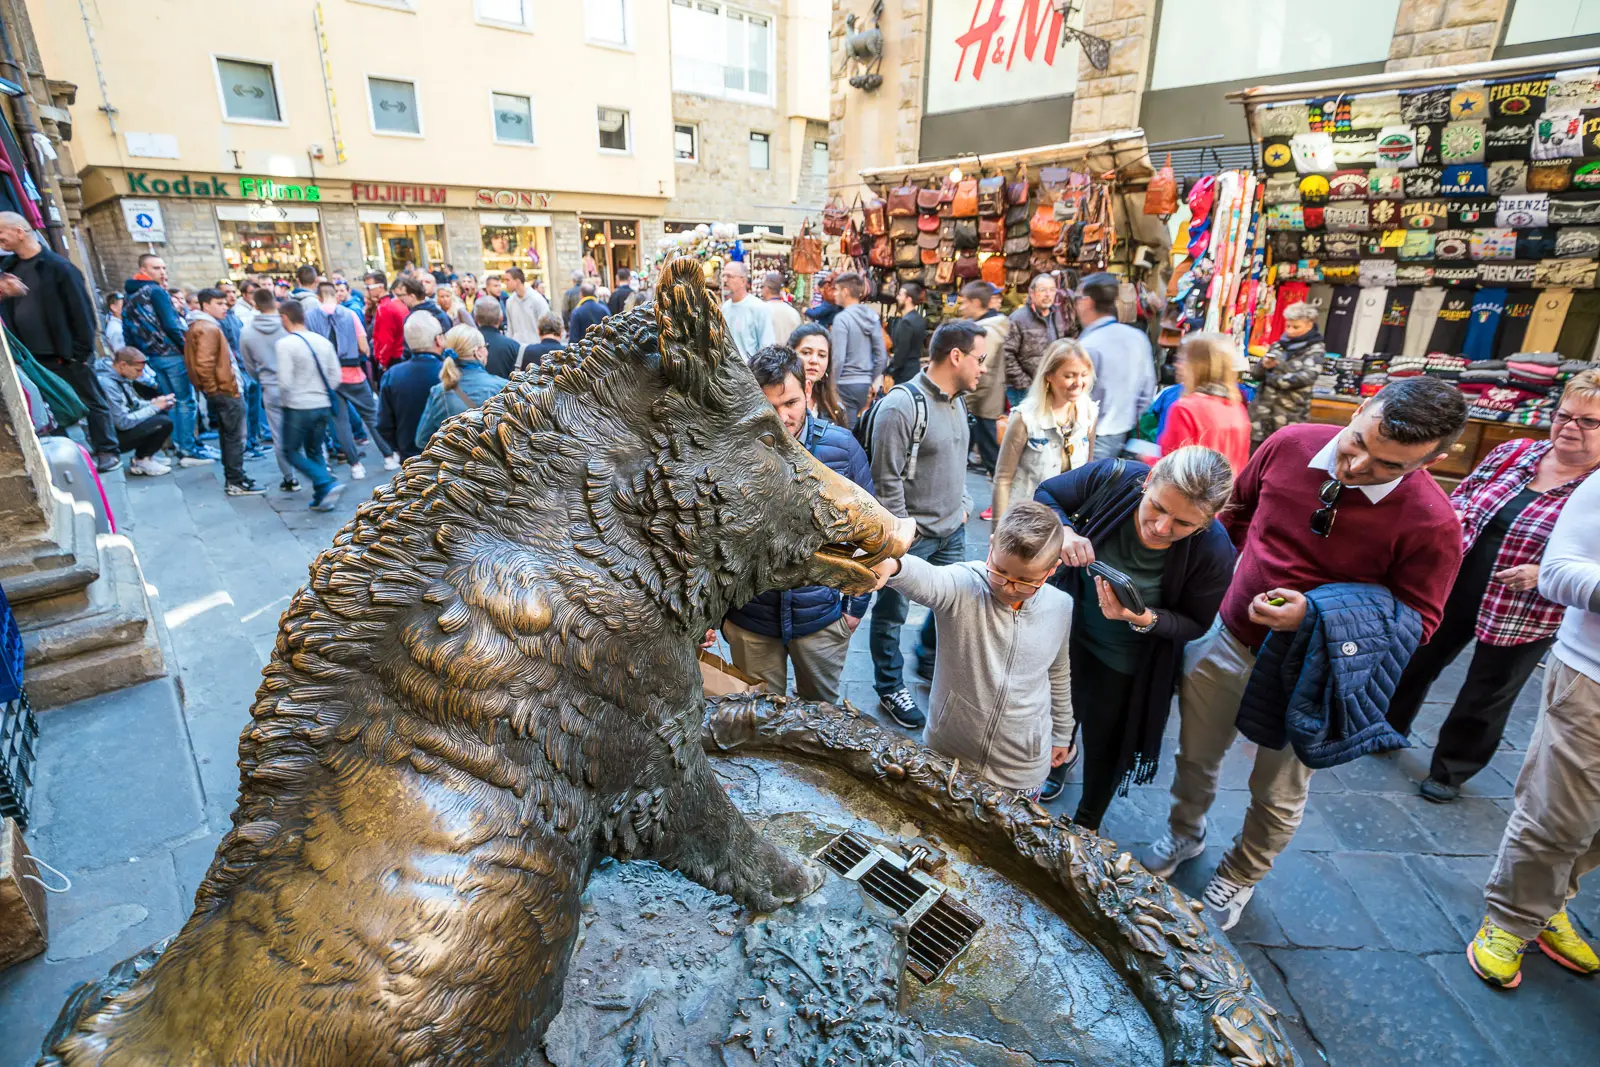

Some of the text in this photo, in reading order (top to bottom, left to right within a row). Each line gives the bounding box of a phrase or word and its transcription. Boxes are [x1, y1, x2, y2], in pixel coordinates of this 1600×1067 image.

[955, 0, 1064, 81] H&M
[1489, 81, 1550, 102] FIRENZE
[127, 171, 321, 203] Kodak Films
[351, 182, 447, 204] FUJIFILM
[1441, 184, 1486, 194] ITALIA
[476, 187, 556, 210] SONY
[1447, 201, 1498, 213] ITALIA
[1498, 198, 1549, 213] FIRENZE
[1401, 201, 1447, 218] ITALIA
[1476, 264, 1537, 282] FIRENZE
[1471, 302, 1504, 314] ITALIA
